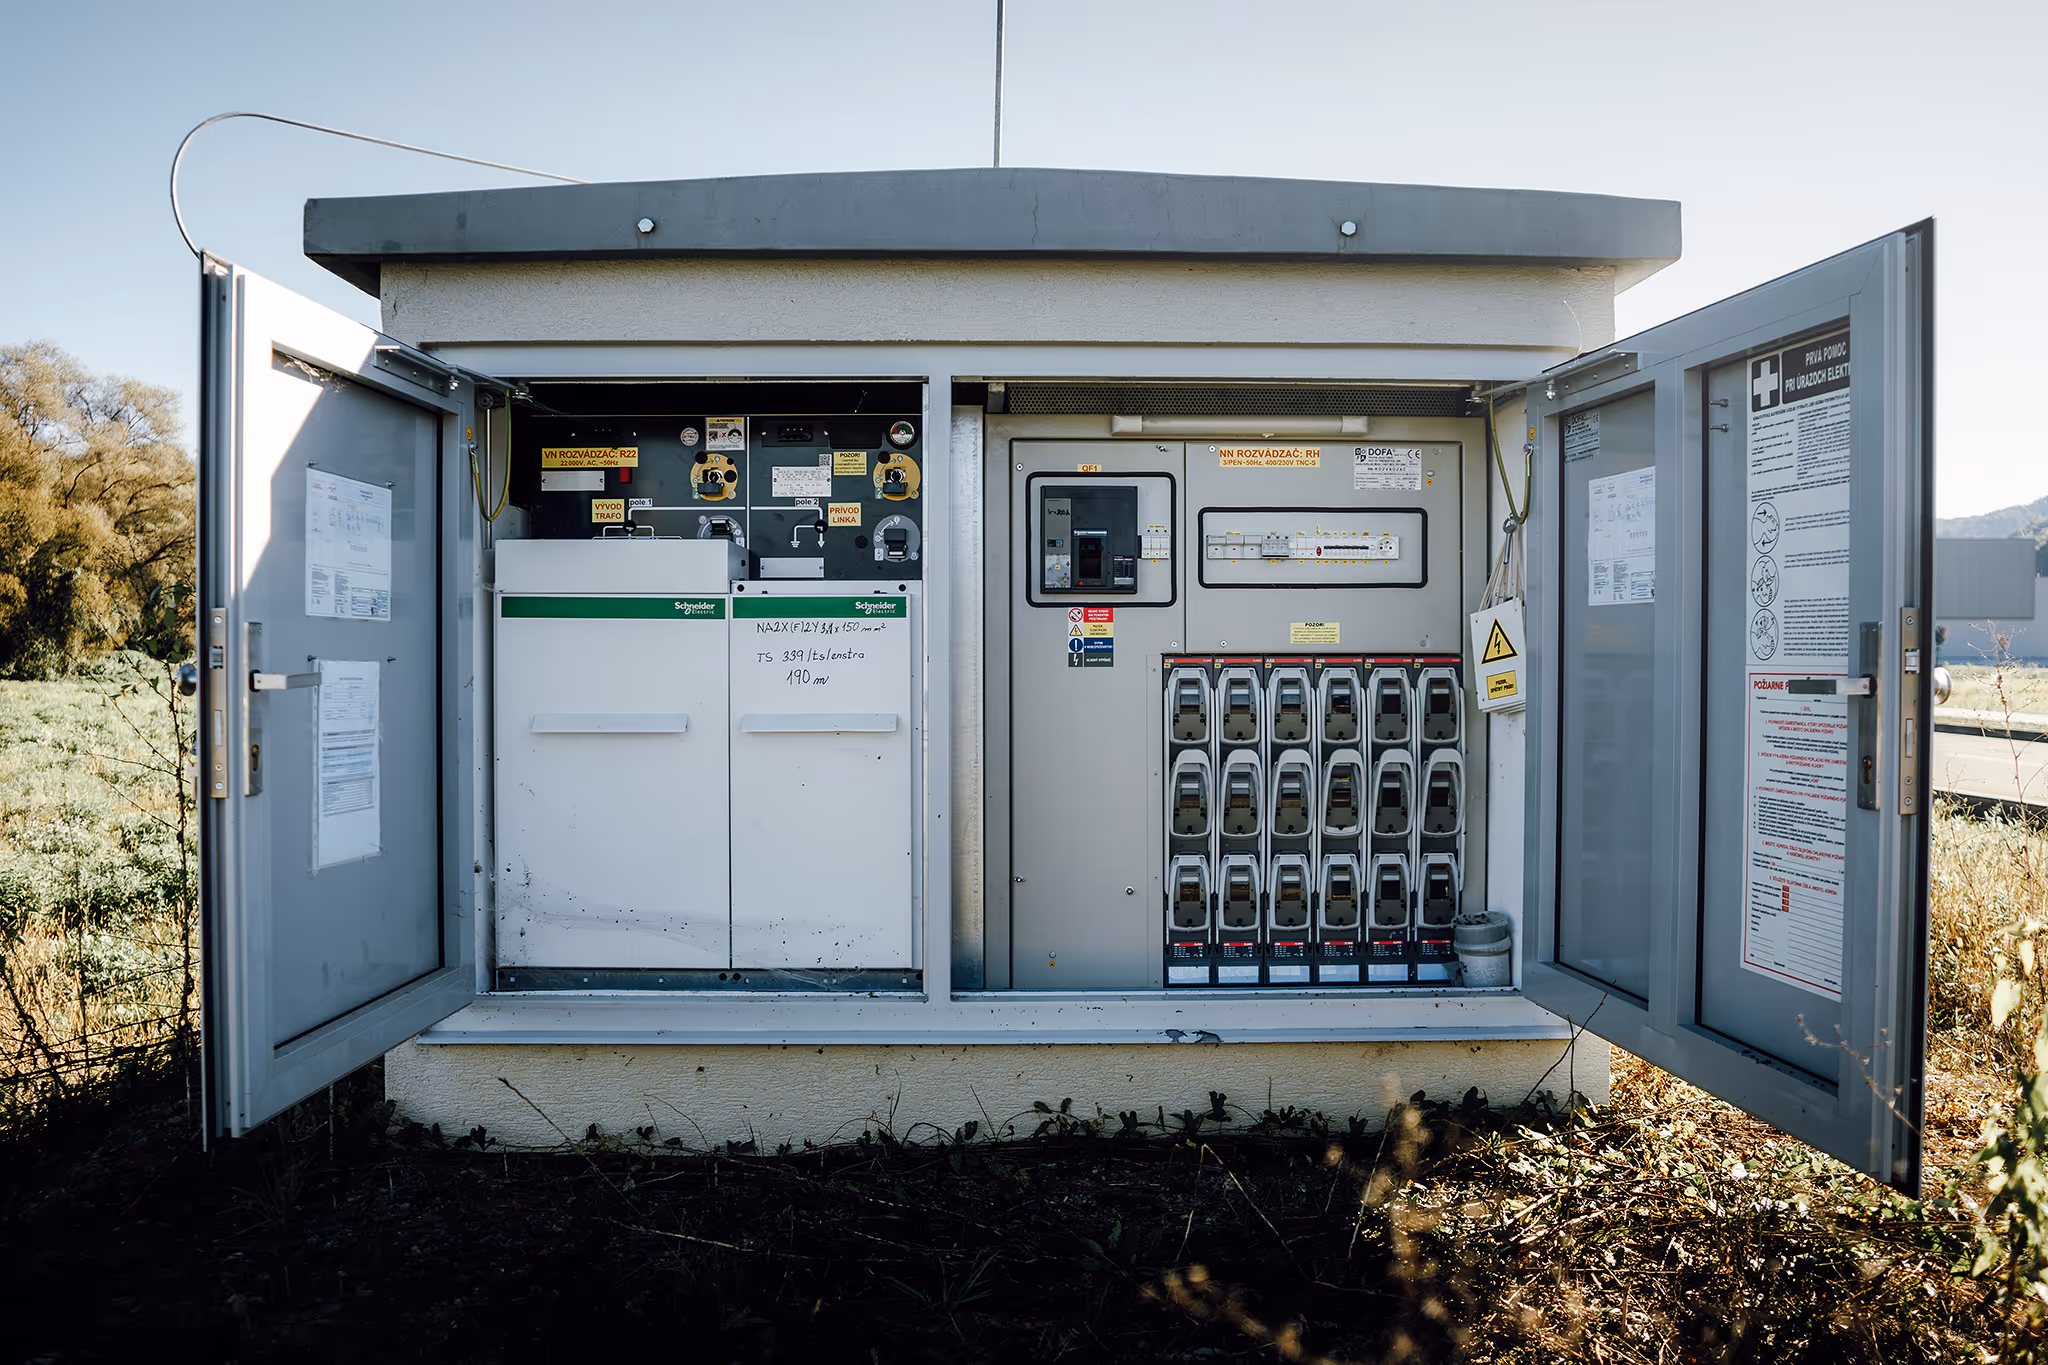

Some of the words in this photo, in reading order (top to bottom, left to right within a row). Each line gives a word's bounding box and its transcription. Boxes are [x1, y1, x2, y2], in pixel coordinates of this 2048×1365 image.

[1805, 345, 1823, 367] PRVÁ
[1823, 341, 1847, 361] POMOC
[1785, 377, 1796, 393] PRI
[1796, 367, 1827, 390] ÚRAZOCH
[544, 450, 557, 459] VN
[559, 448, 618, 459] ROZVÁDZAČ:
[619, 450, 637, 458] R22
[1219, 449, 1234, 458] NN
[1236, 447, 1303, 459] ROZVÁDZAČ:
[1305, 449, 1320, 458] RH
[1368, 448, 1393, 456] DOFA
[1081, 464, 1098, 472] QF1
[594, 501, 623, 511] VÝVOD
[630, 499, 647, 507] pole
[795, 499, 812, 507] pole
[813, 498, 819, 506] 2
[829, 505, 860, 515] PRÍVOD
[594, 512, 623, 520] TRAFO
[832, 516, 857, 524] LINKA
[674, 601, 716, 611] Schneider
[855, 601, 897, 610] Schneider
[757, 651, 774, 663] TS
[782, 649, 804, 662] 339
[786, 668, 811, 685] 190
[1753, 679, 1784, 691] POŽIARNE
